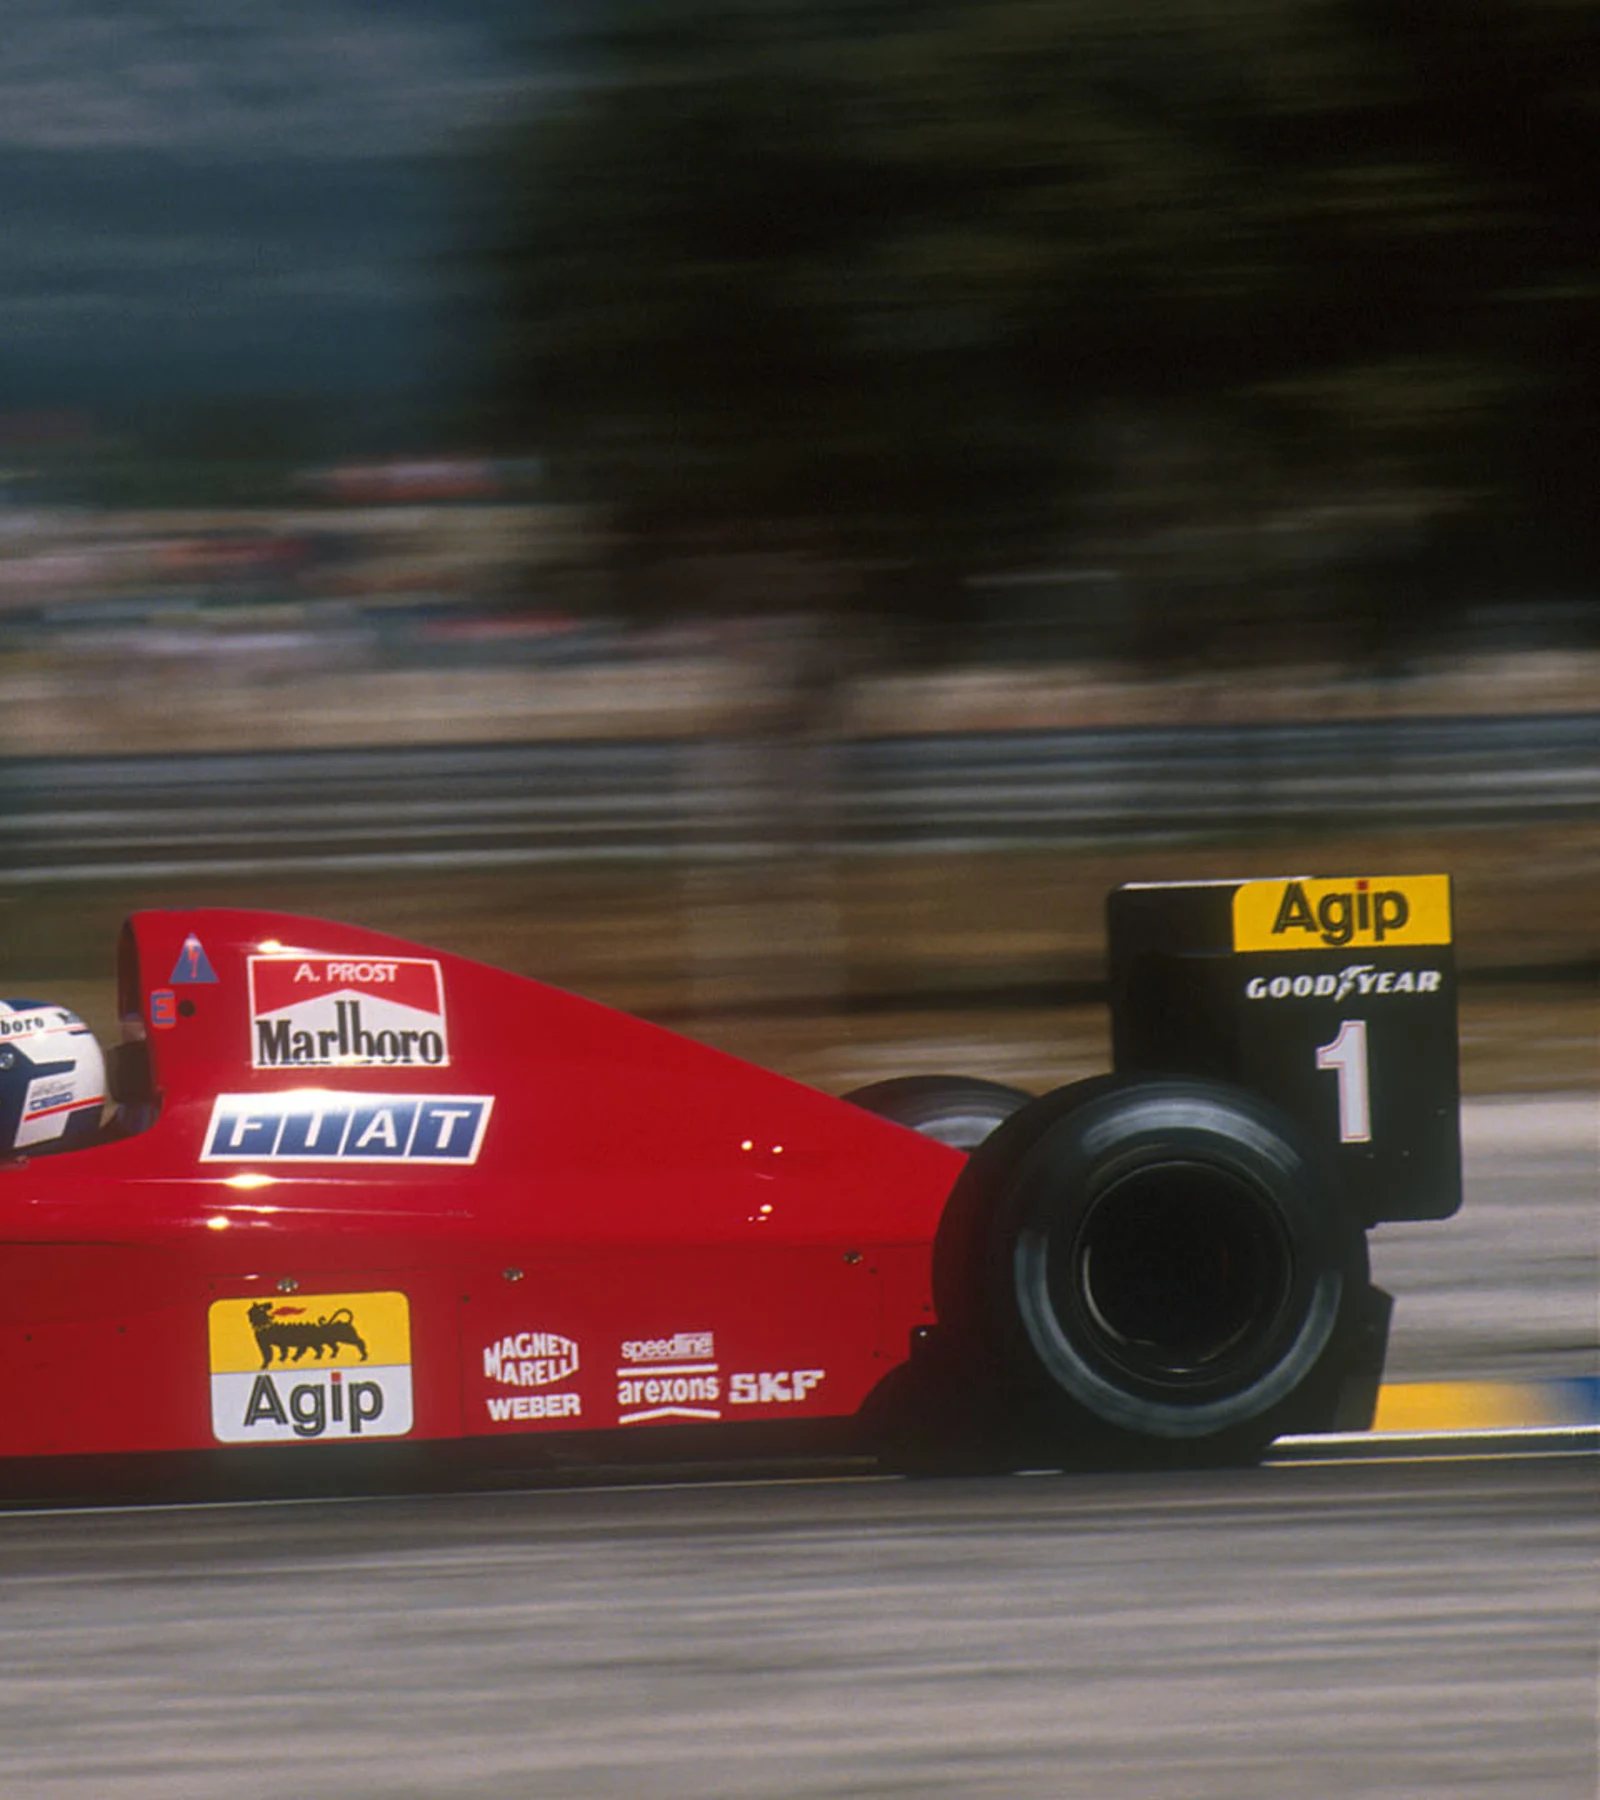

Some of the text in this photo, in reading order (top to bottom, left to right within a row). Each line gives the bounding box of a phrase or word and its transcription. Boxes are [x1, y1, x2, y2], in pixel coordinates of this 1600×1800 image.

[1271, 880, 1409, 945] Agip
[294, 963, 399, 983] A. PROST
[1246, 965, 1442, 1001] GOODYEAR
[255, 1000, 444, 1065] Marlboro
[1316, 1020, 1372, 1143] 1
[228, 1106, 472, 1151] FIAT
[483, 1332, 579, 1368] MAGNETI
[243, 1371, 384, 1437] Agip
[617, 1376, 720, 1405] arexons
[729, 1370, 825, 1404] SKF
[486, 1393, 582, 1421] WEBER
